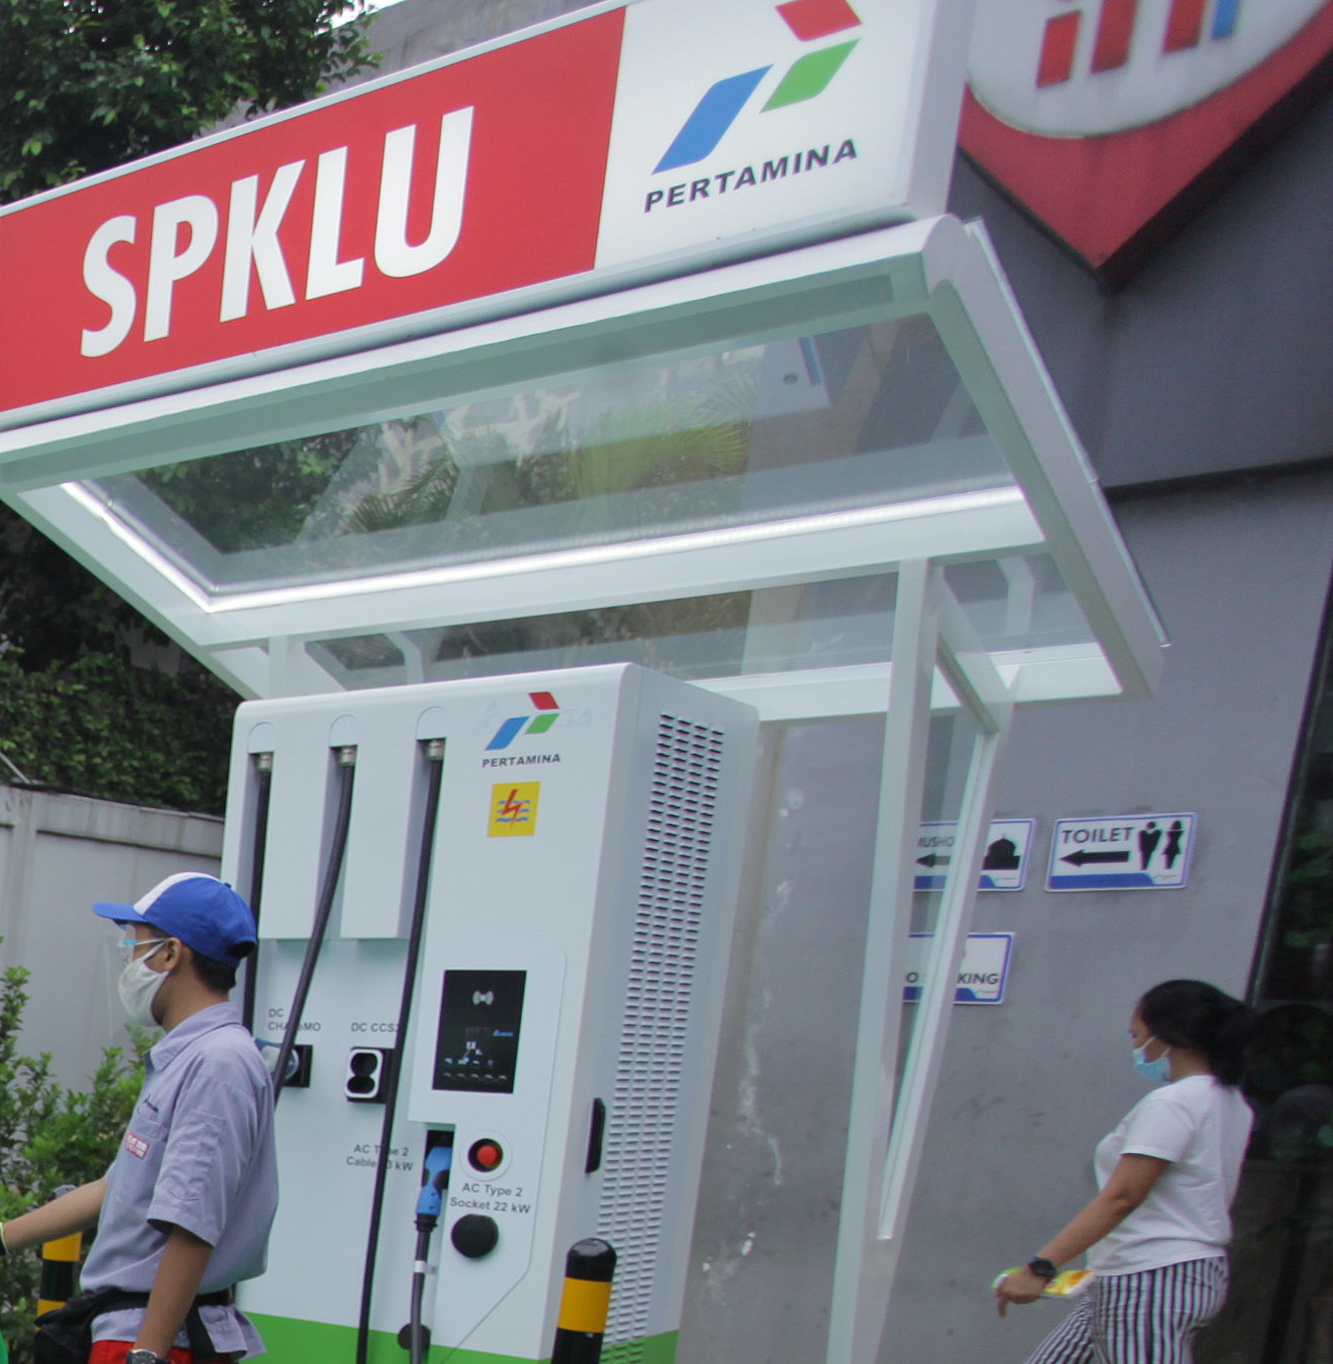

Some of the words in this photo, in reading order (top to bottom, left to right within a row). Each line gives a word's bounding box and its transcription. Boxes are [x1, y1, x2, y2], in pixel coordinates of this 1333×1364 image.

[643, 137, 859, 214] PERTAMINA
[80, 105, 475, 358] SPKLU
[481, 753, 561, 768] PERTAMINA
[1061, 826, 1135, 844] TOILET
[268, 1008, 284, 1018] DC
[351, 1022, 367, 1032] DC
[354, 1144, 371, 1154] AC
[402, 1147, 410, 1157] 2
[462, 1183, 480, 1193] AC
[484, 1184, 512, 1197] Type
[515, 1187, 523, 1197] 2
[449, 1196, 491, 1210] Socket
[493, 1201, 508, 1212] 22
[511, 1203, 531, 1214] kW
